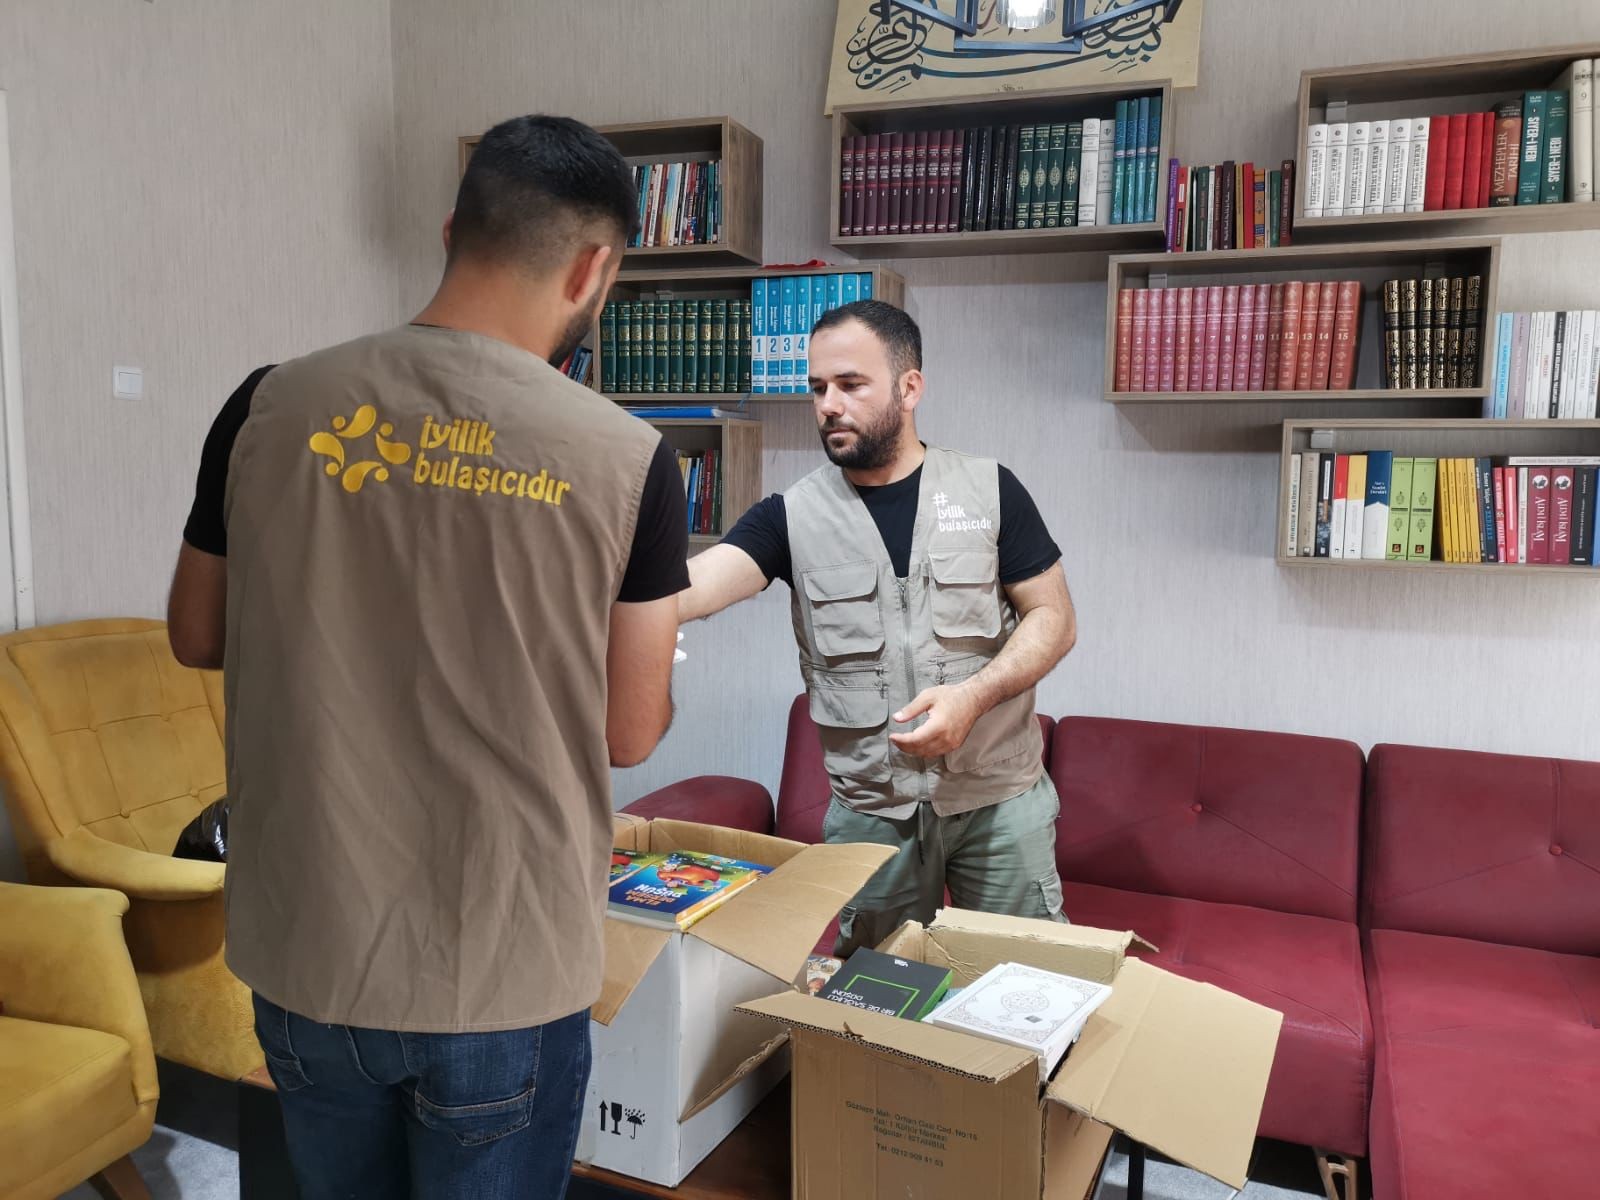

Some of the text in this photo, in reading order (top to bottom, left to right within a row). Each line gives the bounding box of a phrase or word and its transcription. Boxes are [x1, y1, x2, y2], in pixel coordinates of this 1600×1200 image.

[1494, 132, 1507, 192] MEZHEPLER
[755, 338, 761, 353] 1
[770, 338, 777, 353] 2
[783, 337, 791, 352] 3
[797, 336, 805, 351] 4
[413, 452, 571, 506] bulaşıcıdır
[867, 1004, 881, 1013] DE
